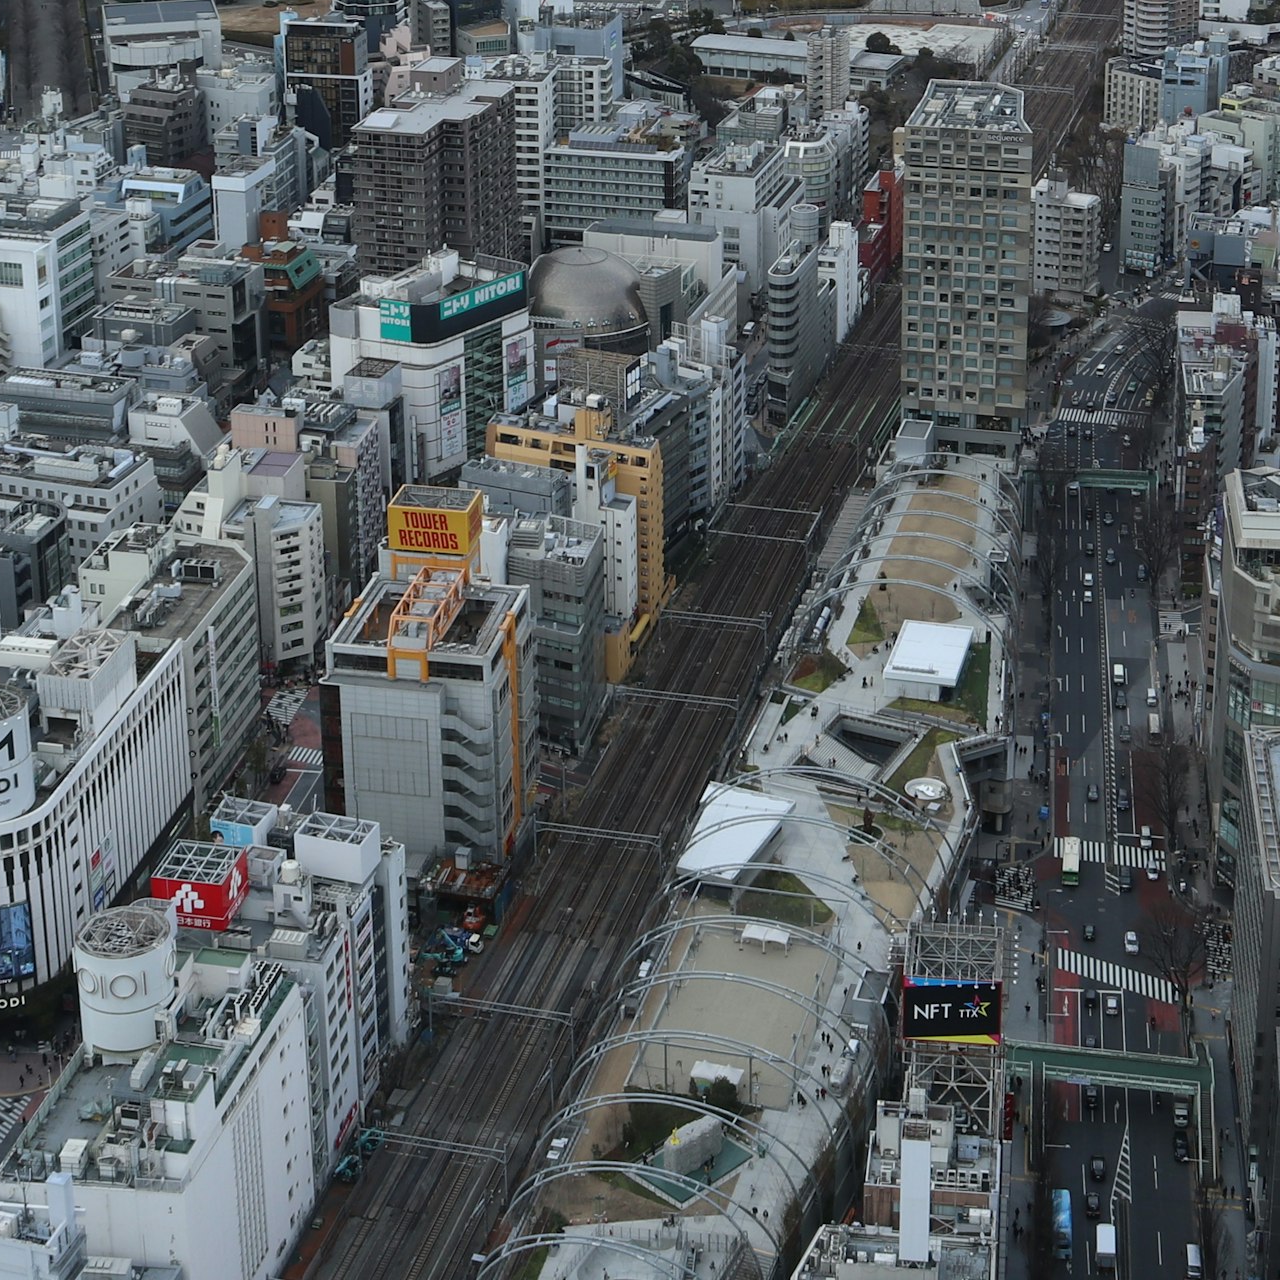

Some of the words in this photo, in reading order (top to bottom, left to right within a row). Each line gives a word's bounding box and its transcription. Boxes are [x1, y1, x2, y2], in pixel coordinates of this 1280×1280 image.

[987, 133, 1025, 143] sequence
[443, 294, 470, 317] ニトリ
[474, 275, 521, 305] NITORI
[380, 302, 410, 316] ニトリ
[381, 317, 410, 327] NITORI
[402, 511, 448, 531] TOWER
[399, 529, 459, 550] RECORDS
[913, 1003, 952, 1020] NFT
[959, 1006, 980, 1018] TTX
